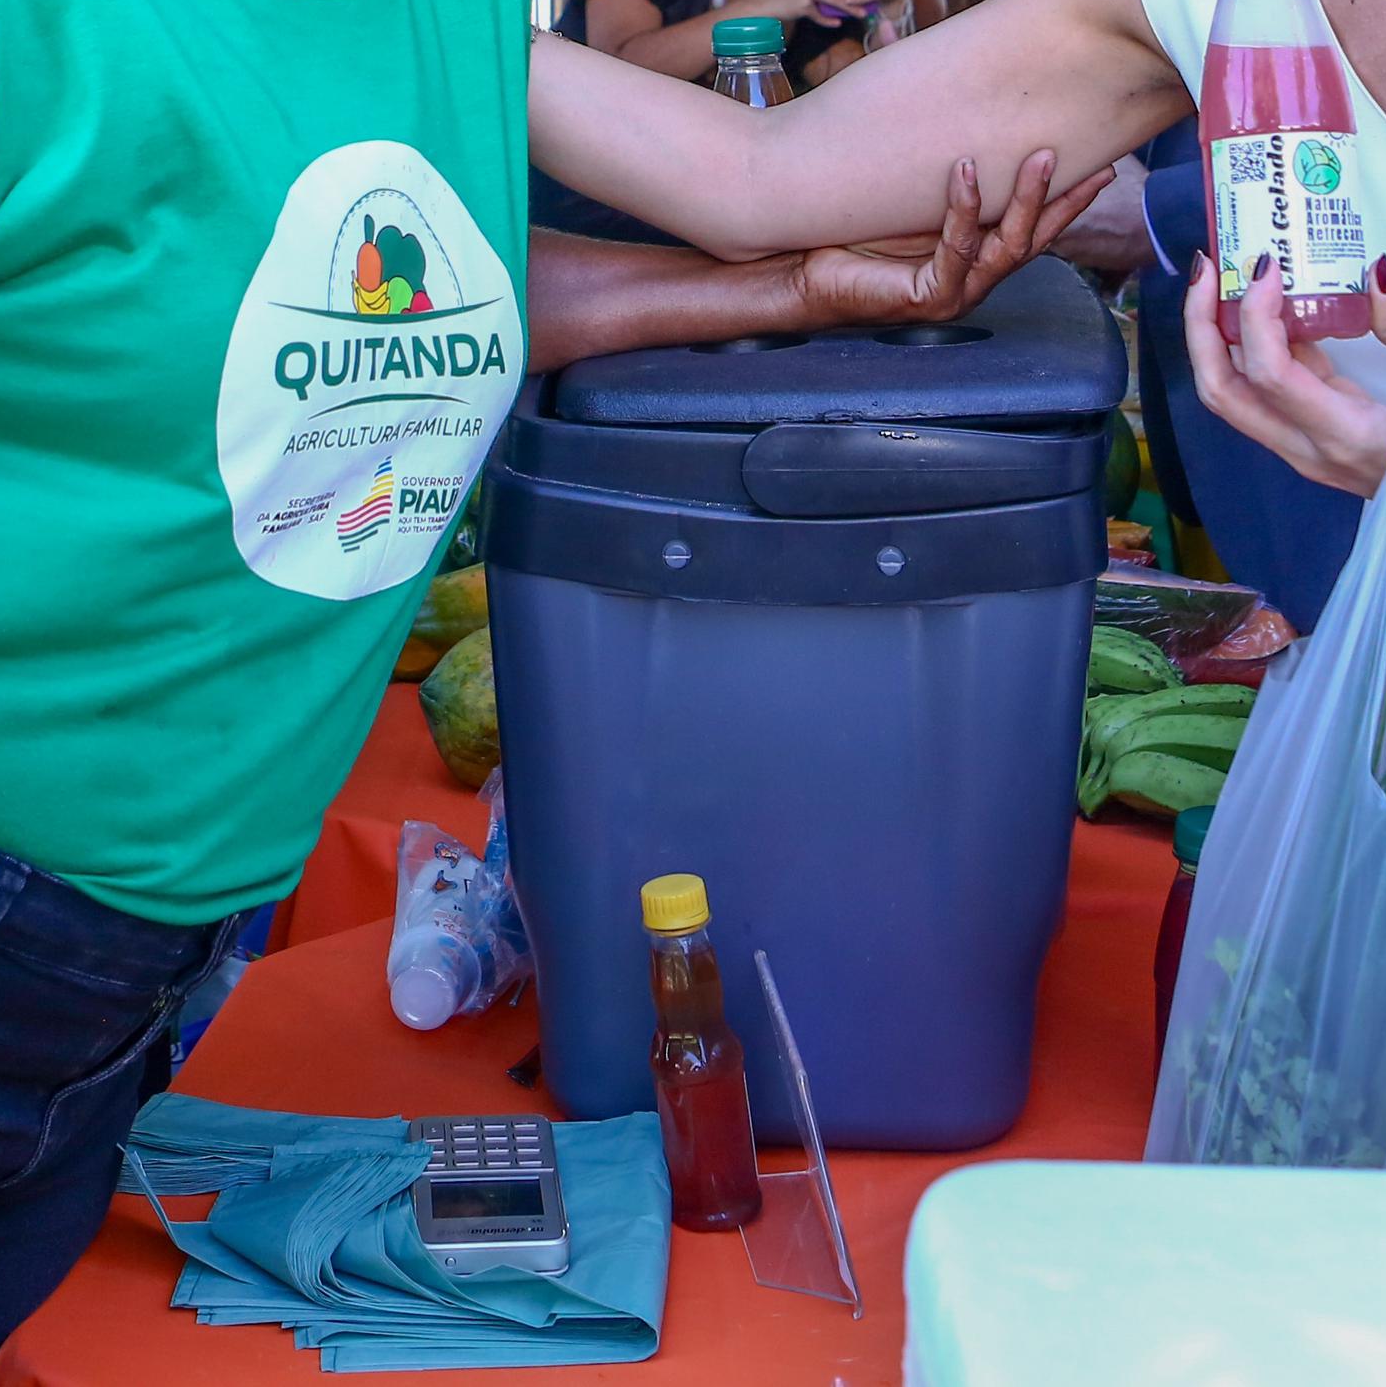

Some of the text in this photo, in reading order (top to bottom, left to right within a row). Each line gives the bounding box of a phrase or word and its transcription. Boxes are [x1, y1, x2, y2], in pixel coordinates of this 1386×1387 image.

[1265, 135, 1290, 231] Gelado
[274, 333, 506, 401] QUITANDA
[283, 417, 483, 456] AGRICULTURA FAMILIAR
[401, 476, 463, 486] GOVERNO DO
[256, 512, 271, 522] DA
[412, 525, 425, 533] TEM
